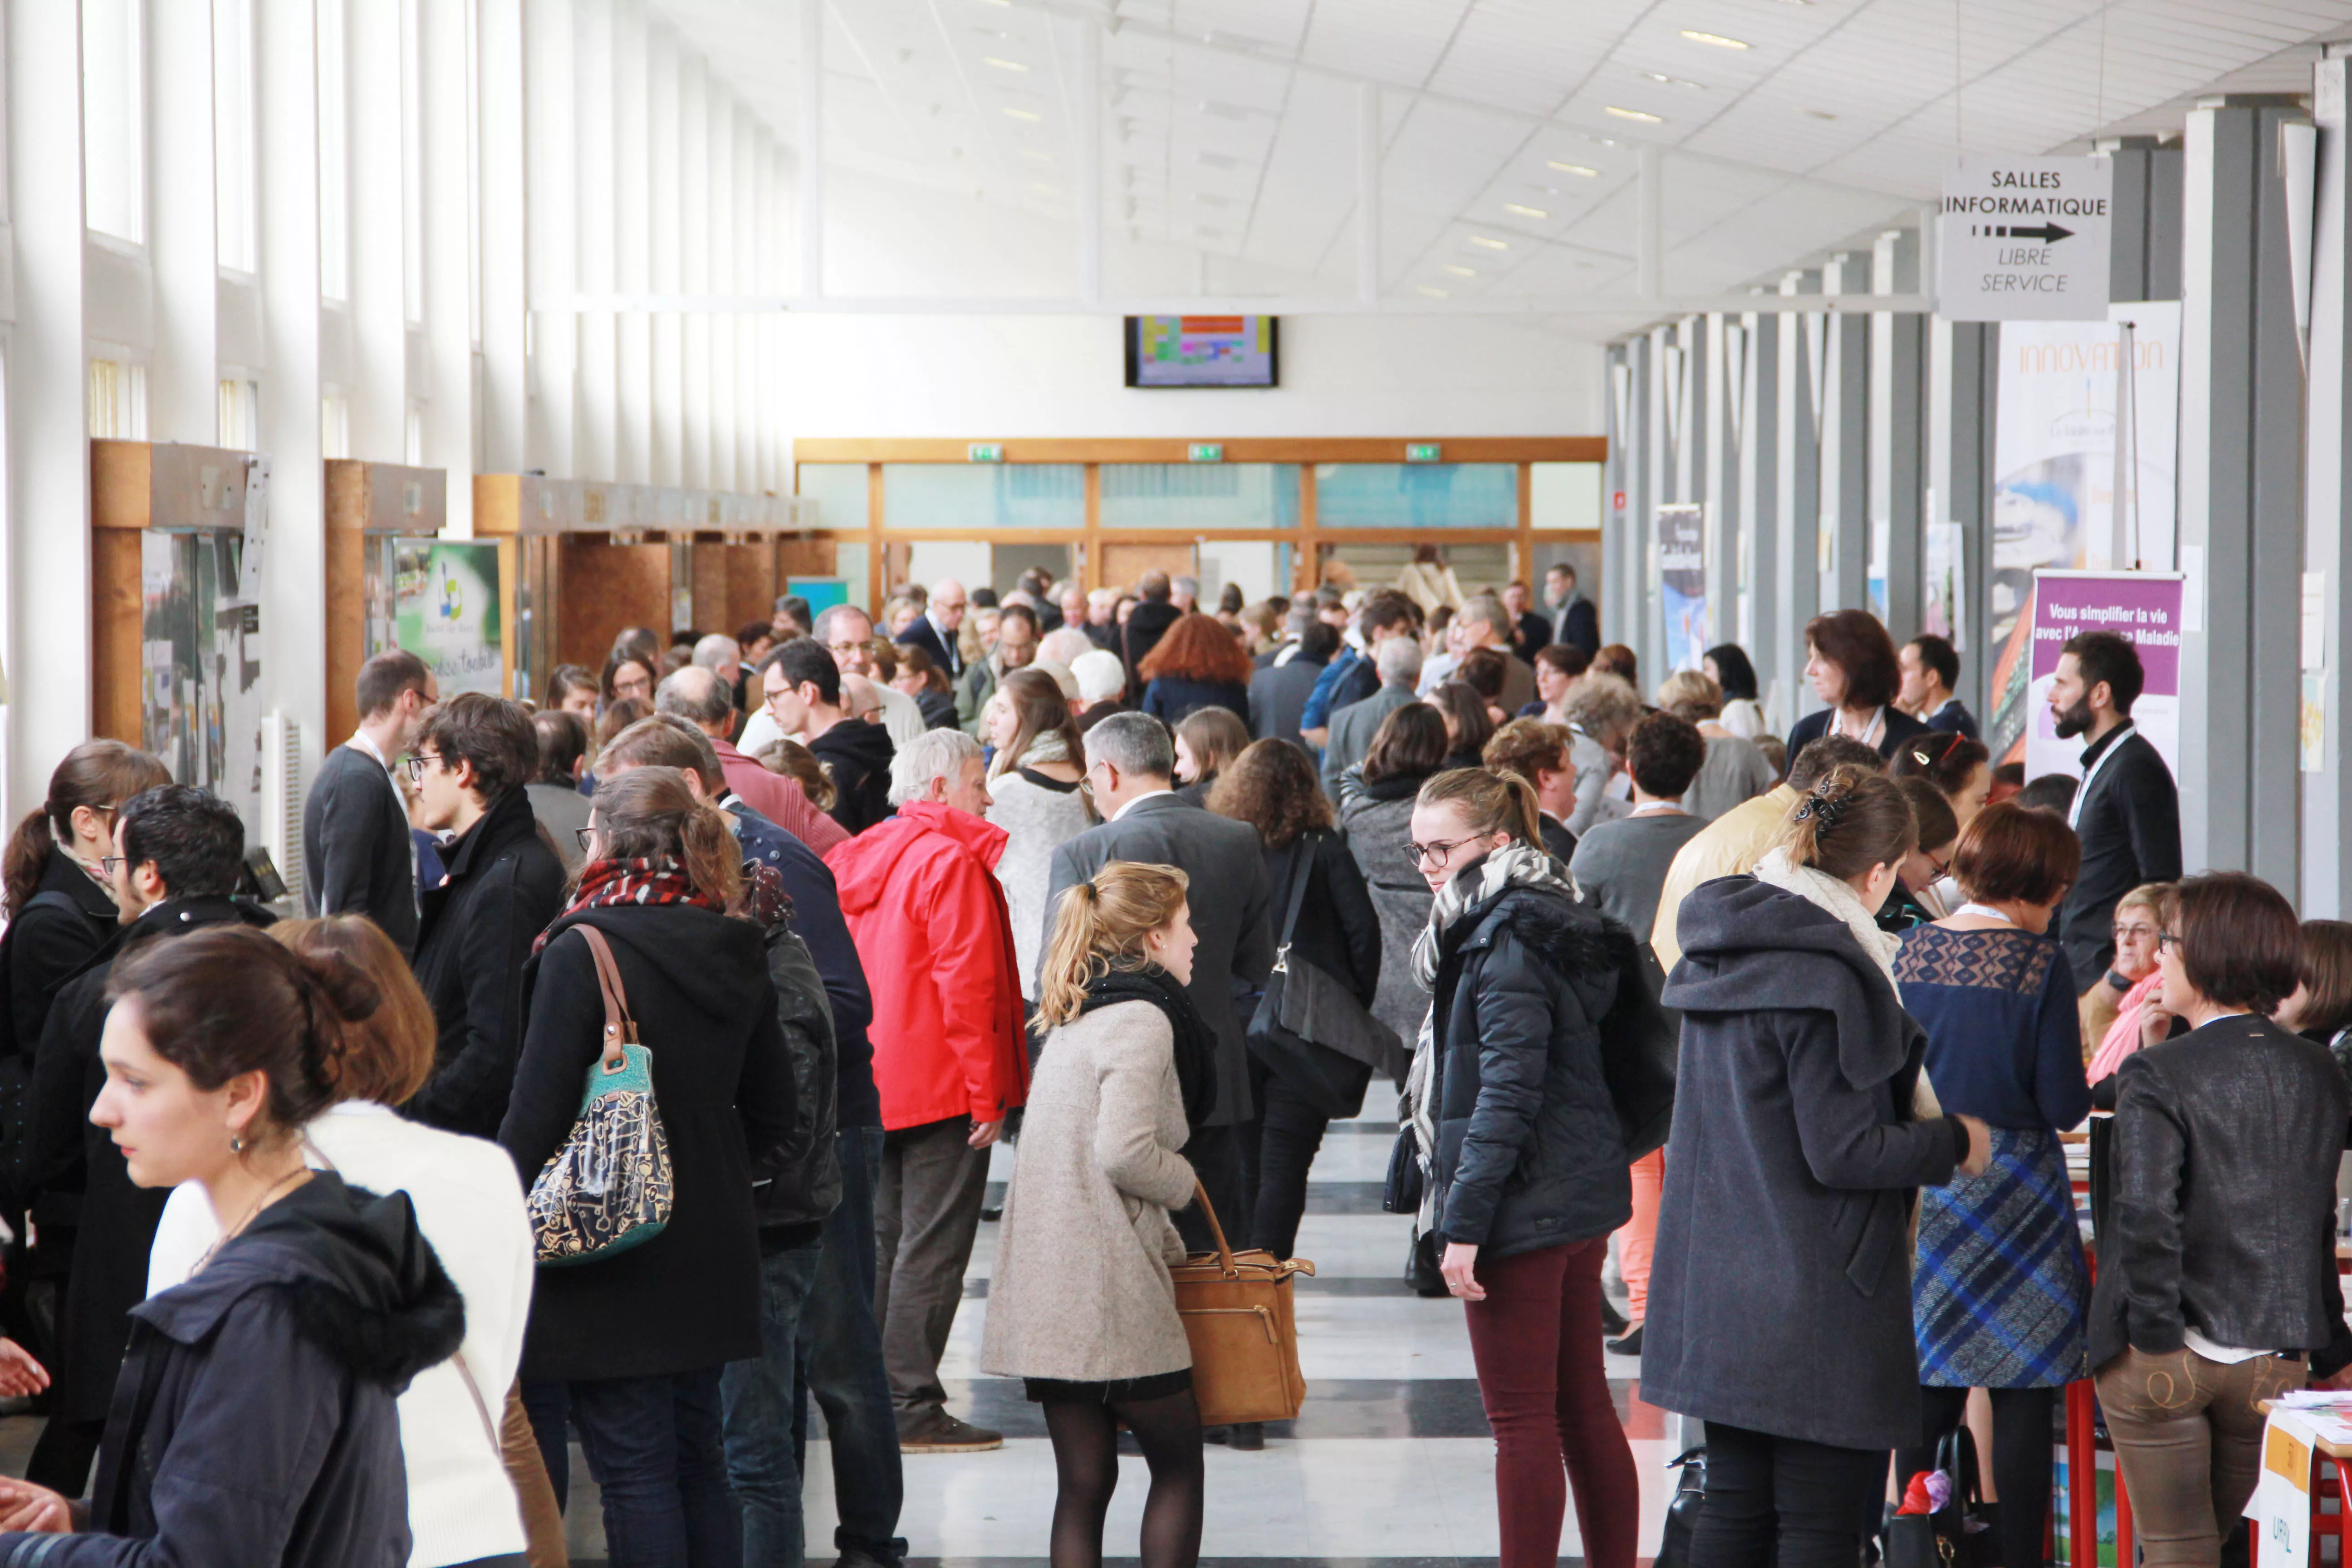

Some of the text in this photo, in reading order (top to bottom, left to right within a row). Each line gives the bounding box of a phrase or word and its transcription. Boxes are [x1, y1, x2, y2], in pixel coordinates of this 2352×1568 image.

[1991, 171, 2061, 188] SALLES
[1946, 196, 2107, 216] INFORMATIQUE
[1999, 248, 2052, 265] LIBRE
[1981, 274, 2068, 292] SERVICE
[2020, 341, 2163, 373] INNOVATON
[2049, 603, 2168, 624] Vous simplifier la vie
[2036, 627, 2063, 640] avec
[2136, 629, 2180, 647] Maladie
